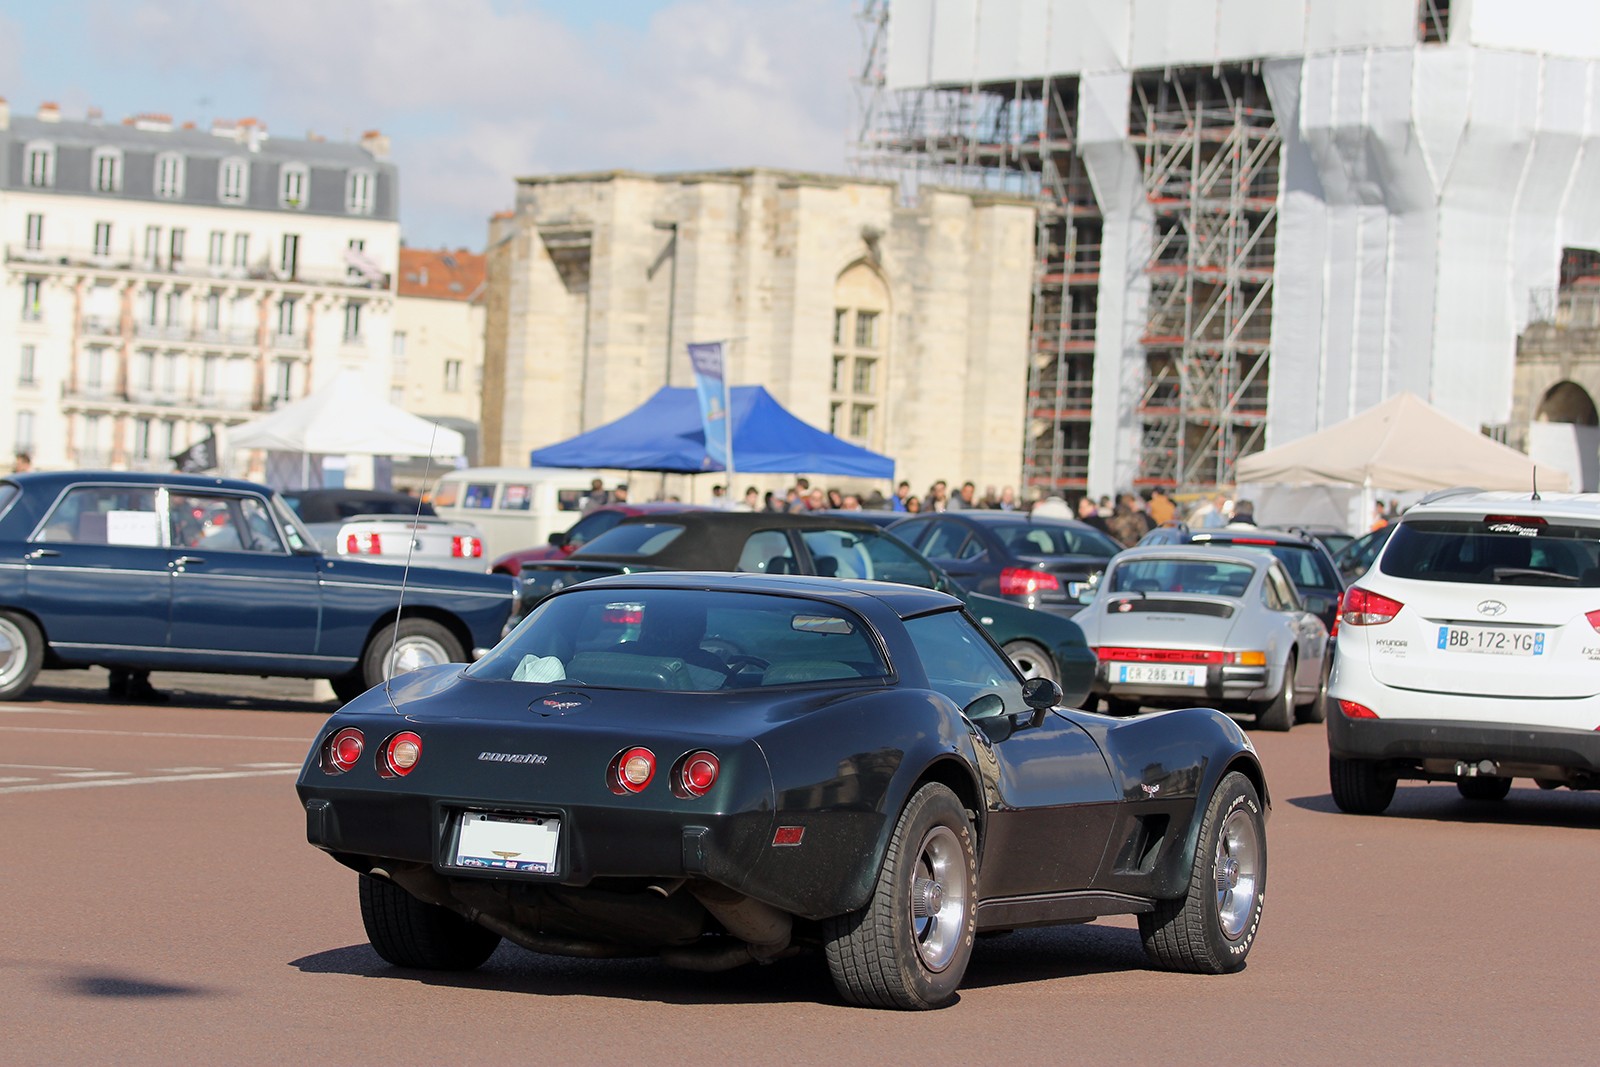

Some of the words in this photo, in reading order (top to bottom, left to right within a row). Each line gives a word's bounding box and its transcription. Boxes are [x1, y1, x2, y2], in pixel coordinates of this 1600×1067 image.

[1376, 639, 1408, 647] HYUNDAI
[1449, 630, 1532, 651] BB-172-YG
[961, 826, 978, 947] Firestone
[1230, 892, 1265, 955] Firestone
